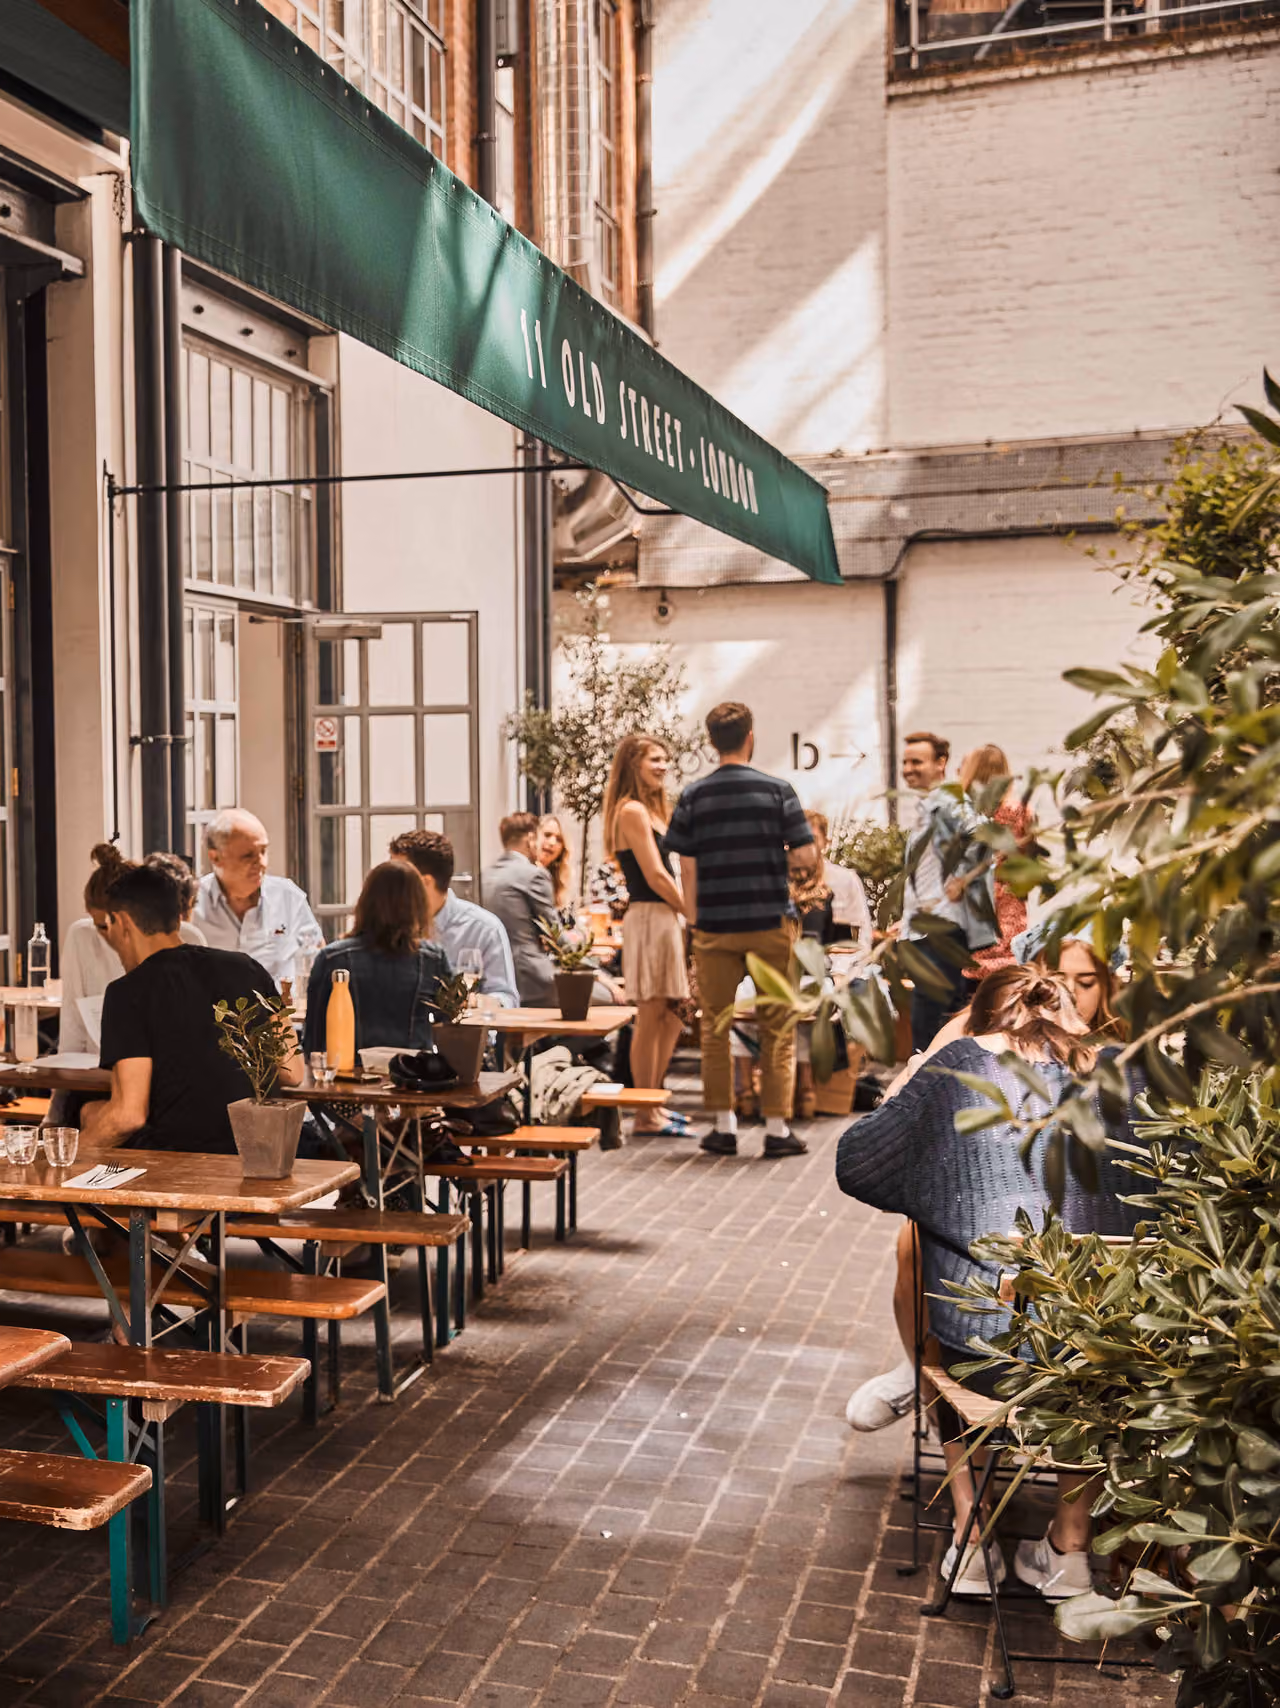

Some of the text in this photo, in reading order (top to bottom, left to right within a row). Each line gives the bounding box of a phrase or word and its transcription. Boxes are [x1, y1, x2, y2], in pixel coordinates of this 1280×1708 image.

[521, 308, 759, 515] 11 OLD STREET LONDON
[791, 732, 819, 770] b
